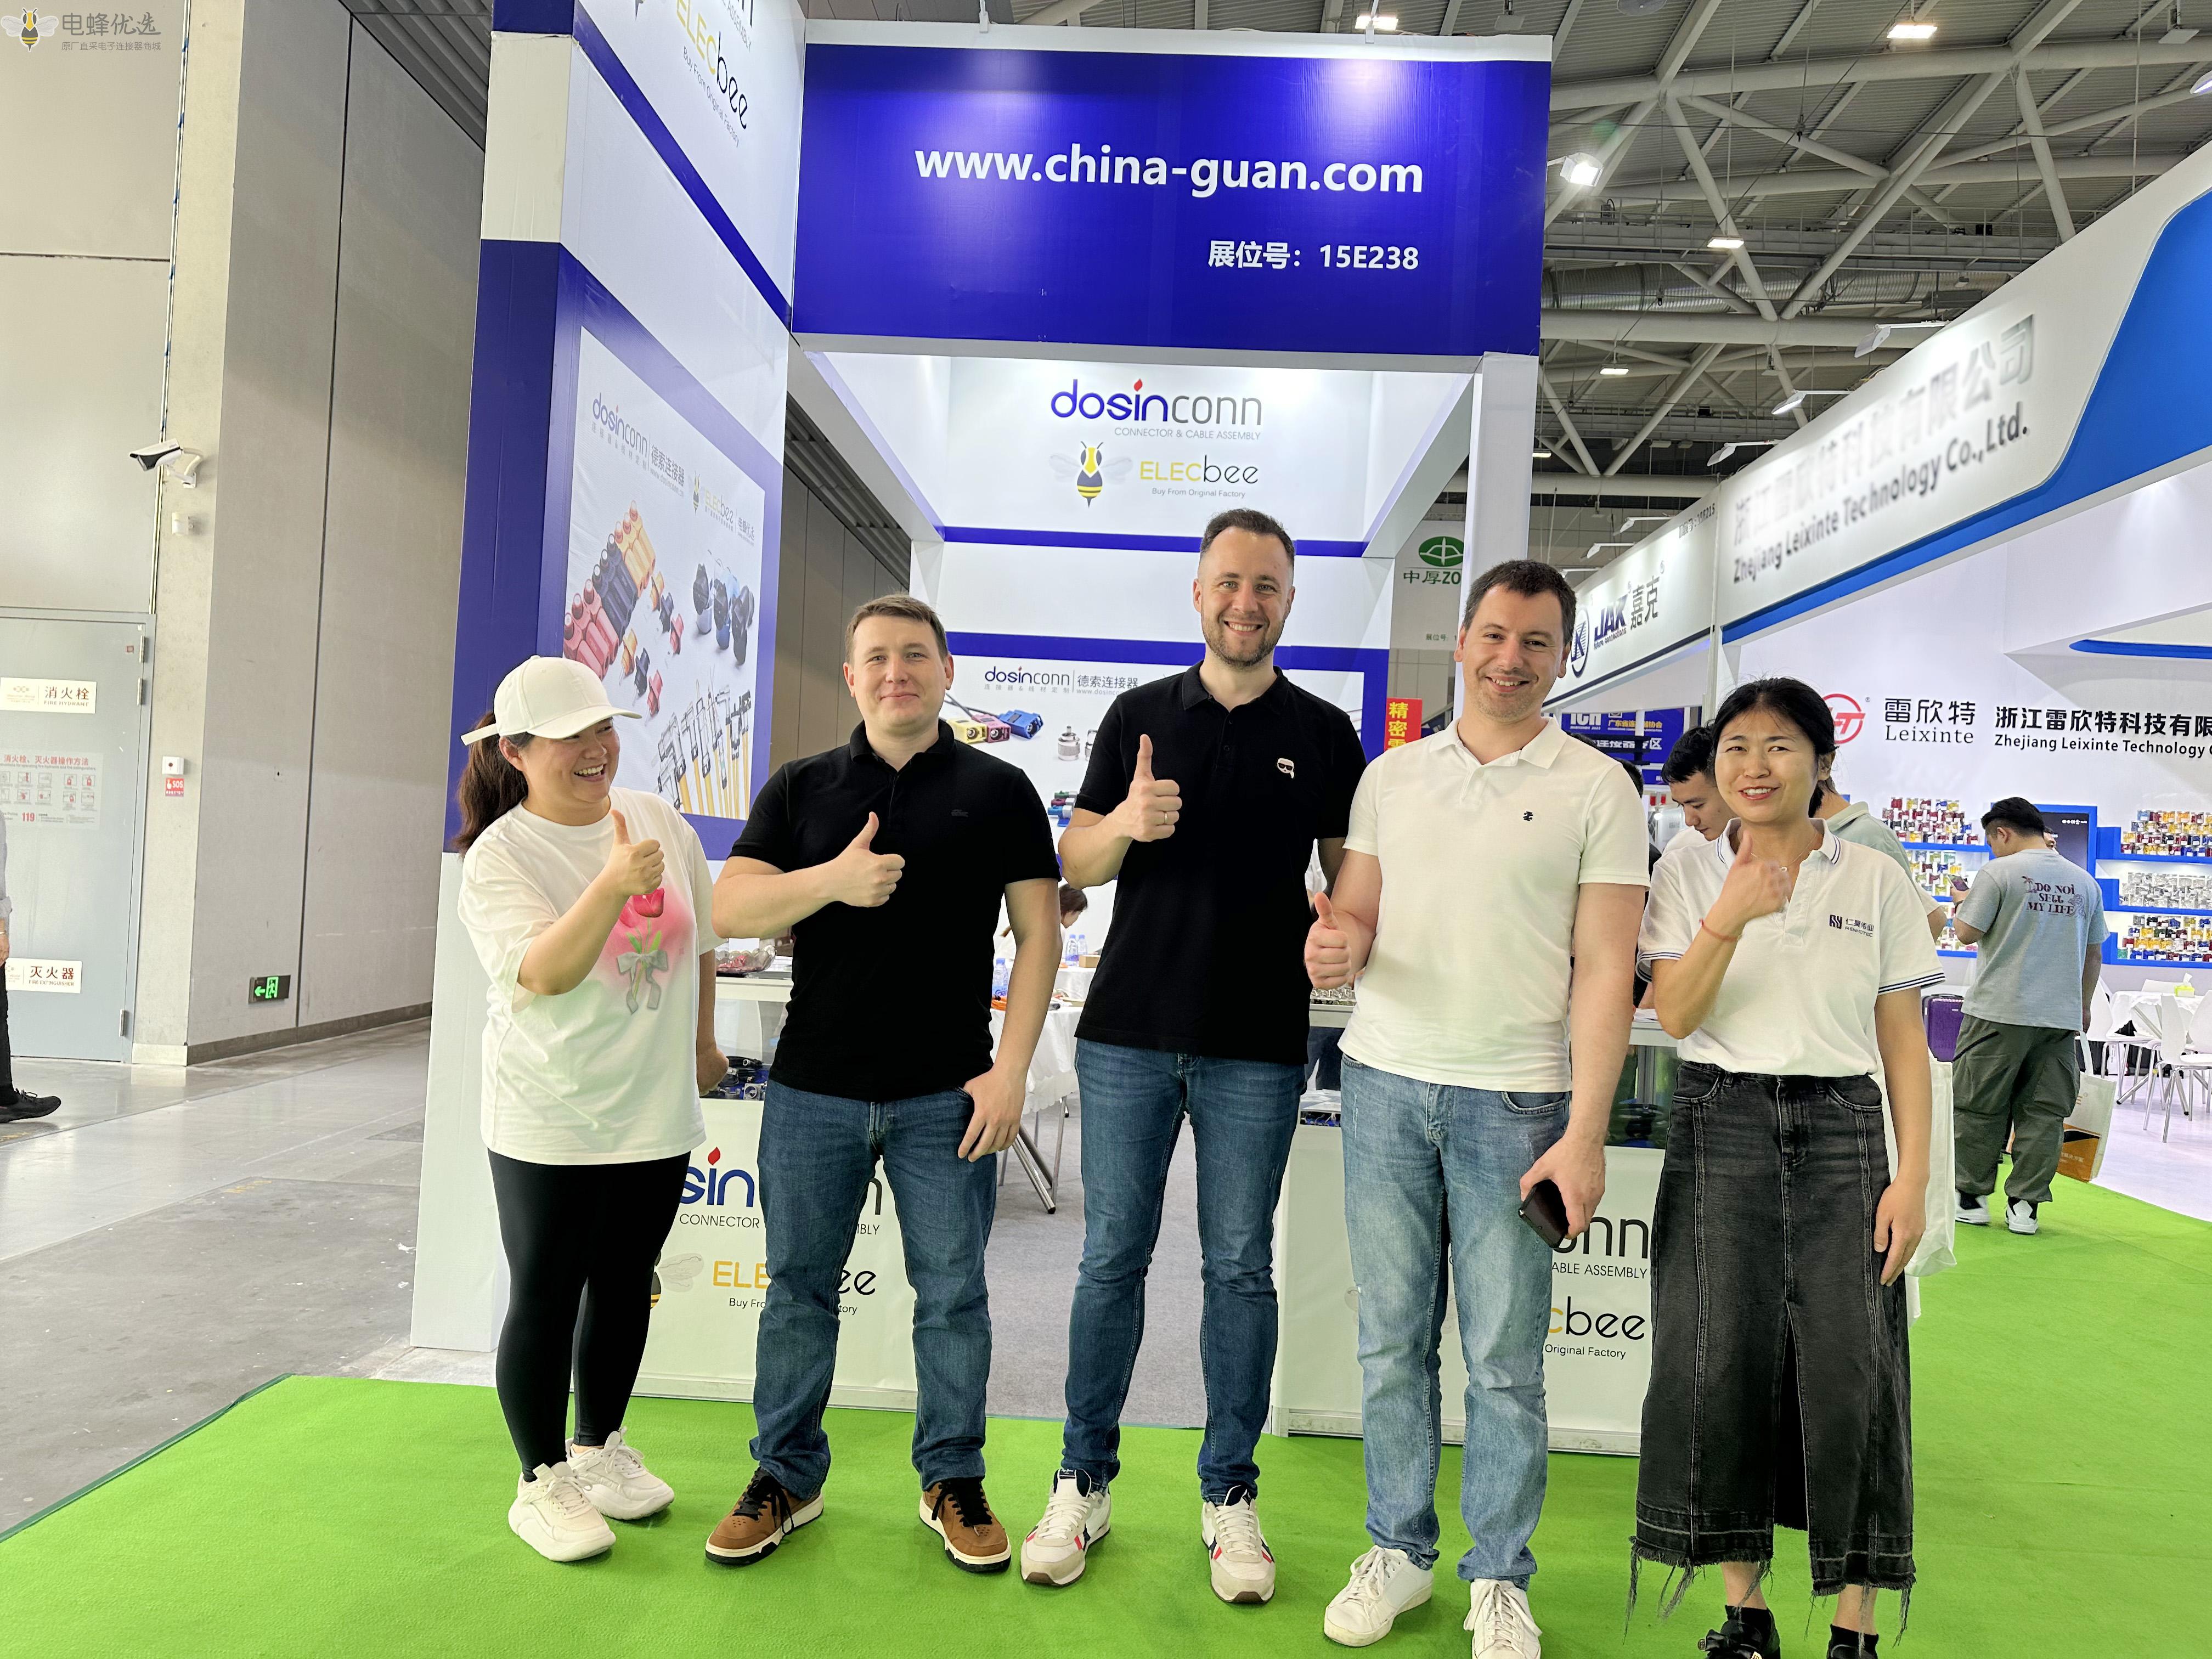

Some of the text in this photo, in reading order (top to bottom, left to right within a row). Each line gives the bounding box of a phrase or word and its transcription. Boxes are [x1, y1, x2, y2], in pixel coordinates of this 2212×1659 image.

[684, 46, 740, 148] Buy From Original Factory
[915, 143, 1423, 198] www.china-guan.com
[1051, 379, 1262, 425] dosinconn
[592, 392, 647, 458] dosinconn
[1114, 427, 1261, 441] CONNECTOR & CABLE ASSEMBLY
[651, 445, 685, 487] 德索连接器
[1139, 455, 1259, 484] ELECbee
[1152, 488, 1166, 496] Buy
[1188, 489, 1216, 498] Original
[1218, 490, 1246, 499] Factory
[705, 489, 733, 524] ELECbee
[1734, 541, 1782, 584] Zhejiang
[1786, 511, 1838, 556] Leixinte
[1844, 454, 1942, 527] Technology
[1403, 570, 1462, 584] 中厚ZO
[1594, 575, 1660, 641] JAK 嘉克
[985, 666, 1070, 685] dosinconn
[1077, 675, 1138, 689] 德索连接器
[45, 686, 89, 700] 消火栓
[1885, 698, 1976, 725] 雷欣特
[1995, 707, 2212, 737] 浙江雷欣特科技有限
[1886, 725, 1974, 743] Leixinte
[1995, 735, 2057, 751] Zhejiang
[2062, 737, 2118, 751] Leixinte
[2123, 740, 2206, 758] Technology
[4, 754, 89, 766] 消火栓、灭火器操作方法
[172, 780, 183, 788] SOS
[22, 812, 35, 822] 119
[2026, 901, 2075, 914] MY LIFE
[30, 966, 75, 980] 灭火器
[680, 1214, 760, 1228] CONNECTOR
[1552, 1262, 1647, 1279] ABLE ASSEMBLY
[729, 1297, 748, 1308] Buy
[751, 1299, 766, 1308] Fro
[1545, 1344, 1626, 1360] Original Factory
